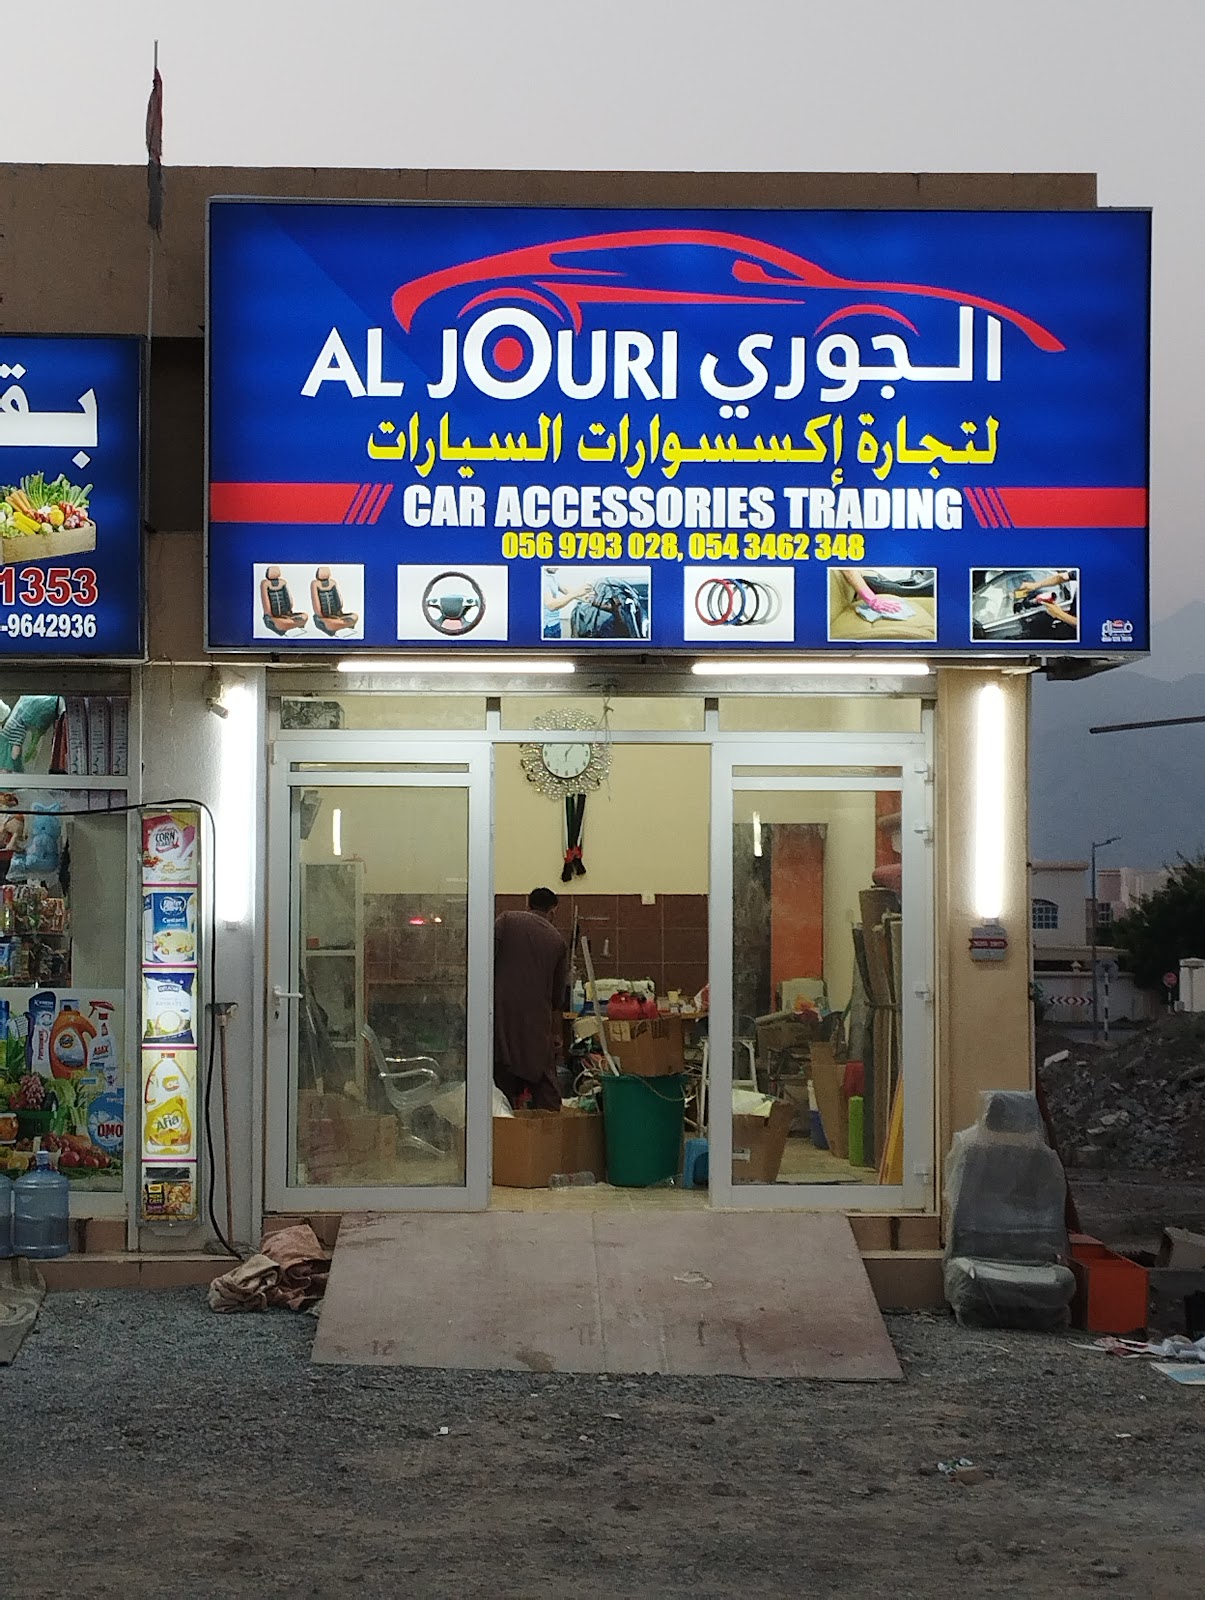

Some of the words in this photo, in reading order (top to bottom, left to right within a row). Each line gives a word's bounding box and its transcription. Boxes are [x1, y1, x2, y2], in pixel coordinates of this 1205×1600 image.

[301, 326, 405, 398] AL
[427, 307, 678, 400] JOURI
[699, 306, 1002, 420] الجوري
[367, 411, 563, 479] السيارات
[577, 411, 843, 486] إكسسوارات
[857, 413, 999, 480] لتجارة
[403, 484, 486, 528] CAR
[494, 486, 776, 529] ACCESSORIES
[783, 486, 963, 530] TRADING
[502, 532, 553, 559] 056
[558, 533, 623, 559] 9793
[627, 533, 684, 562] 028,
[688, 533, 739, 561] 054
[743, 533, 810, 561] 3462
[814, 534, 865, 561] 348
[155, 830, 176, 843] CORN
[156, 1115, 180, 1132] Afia
